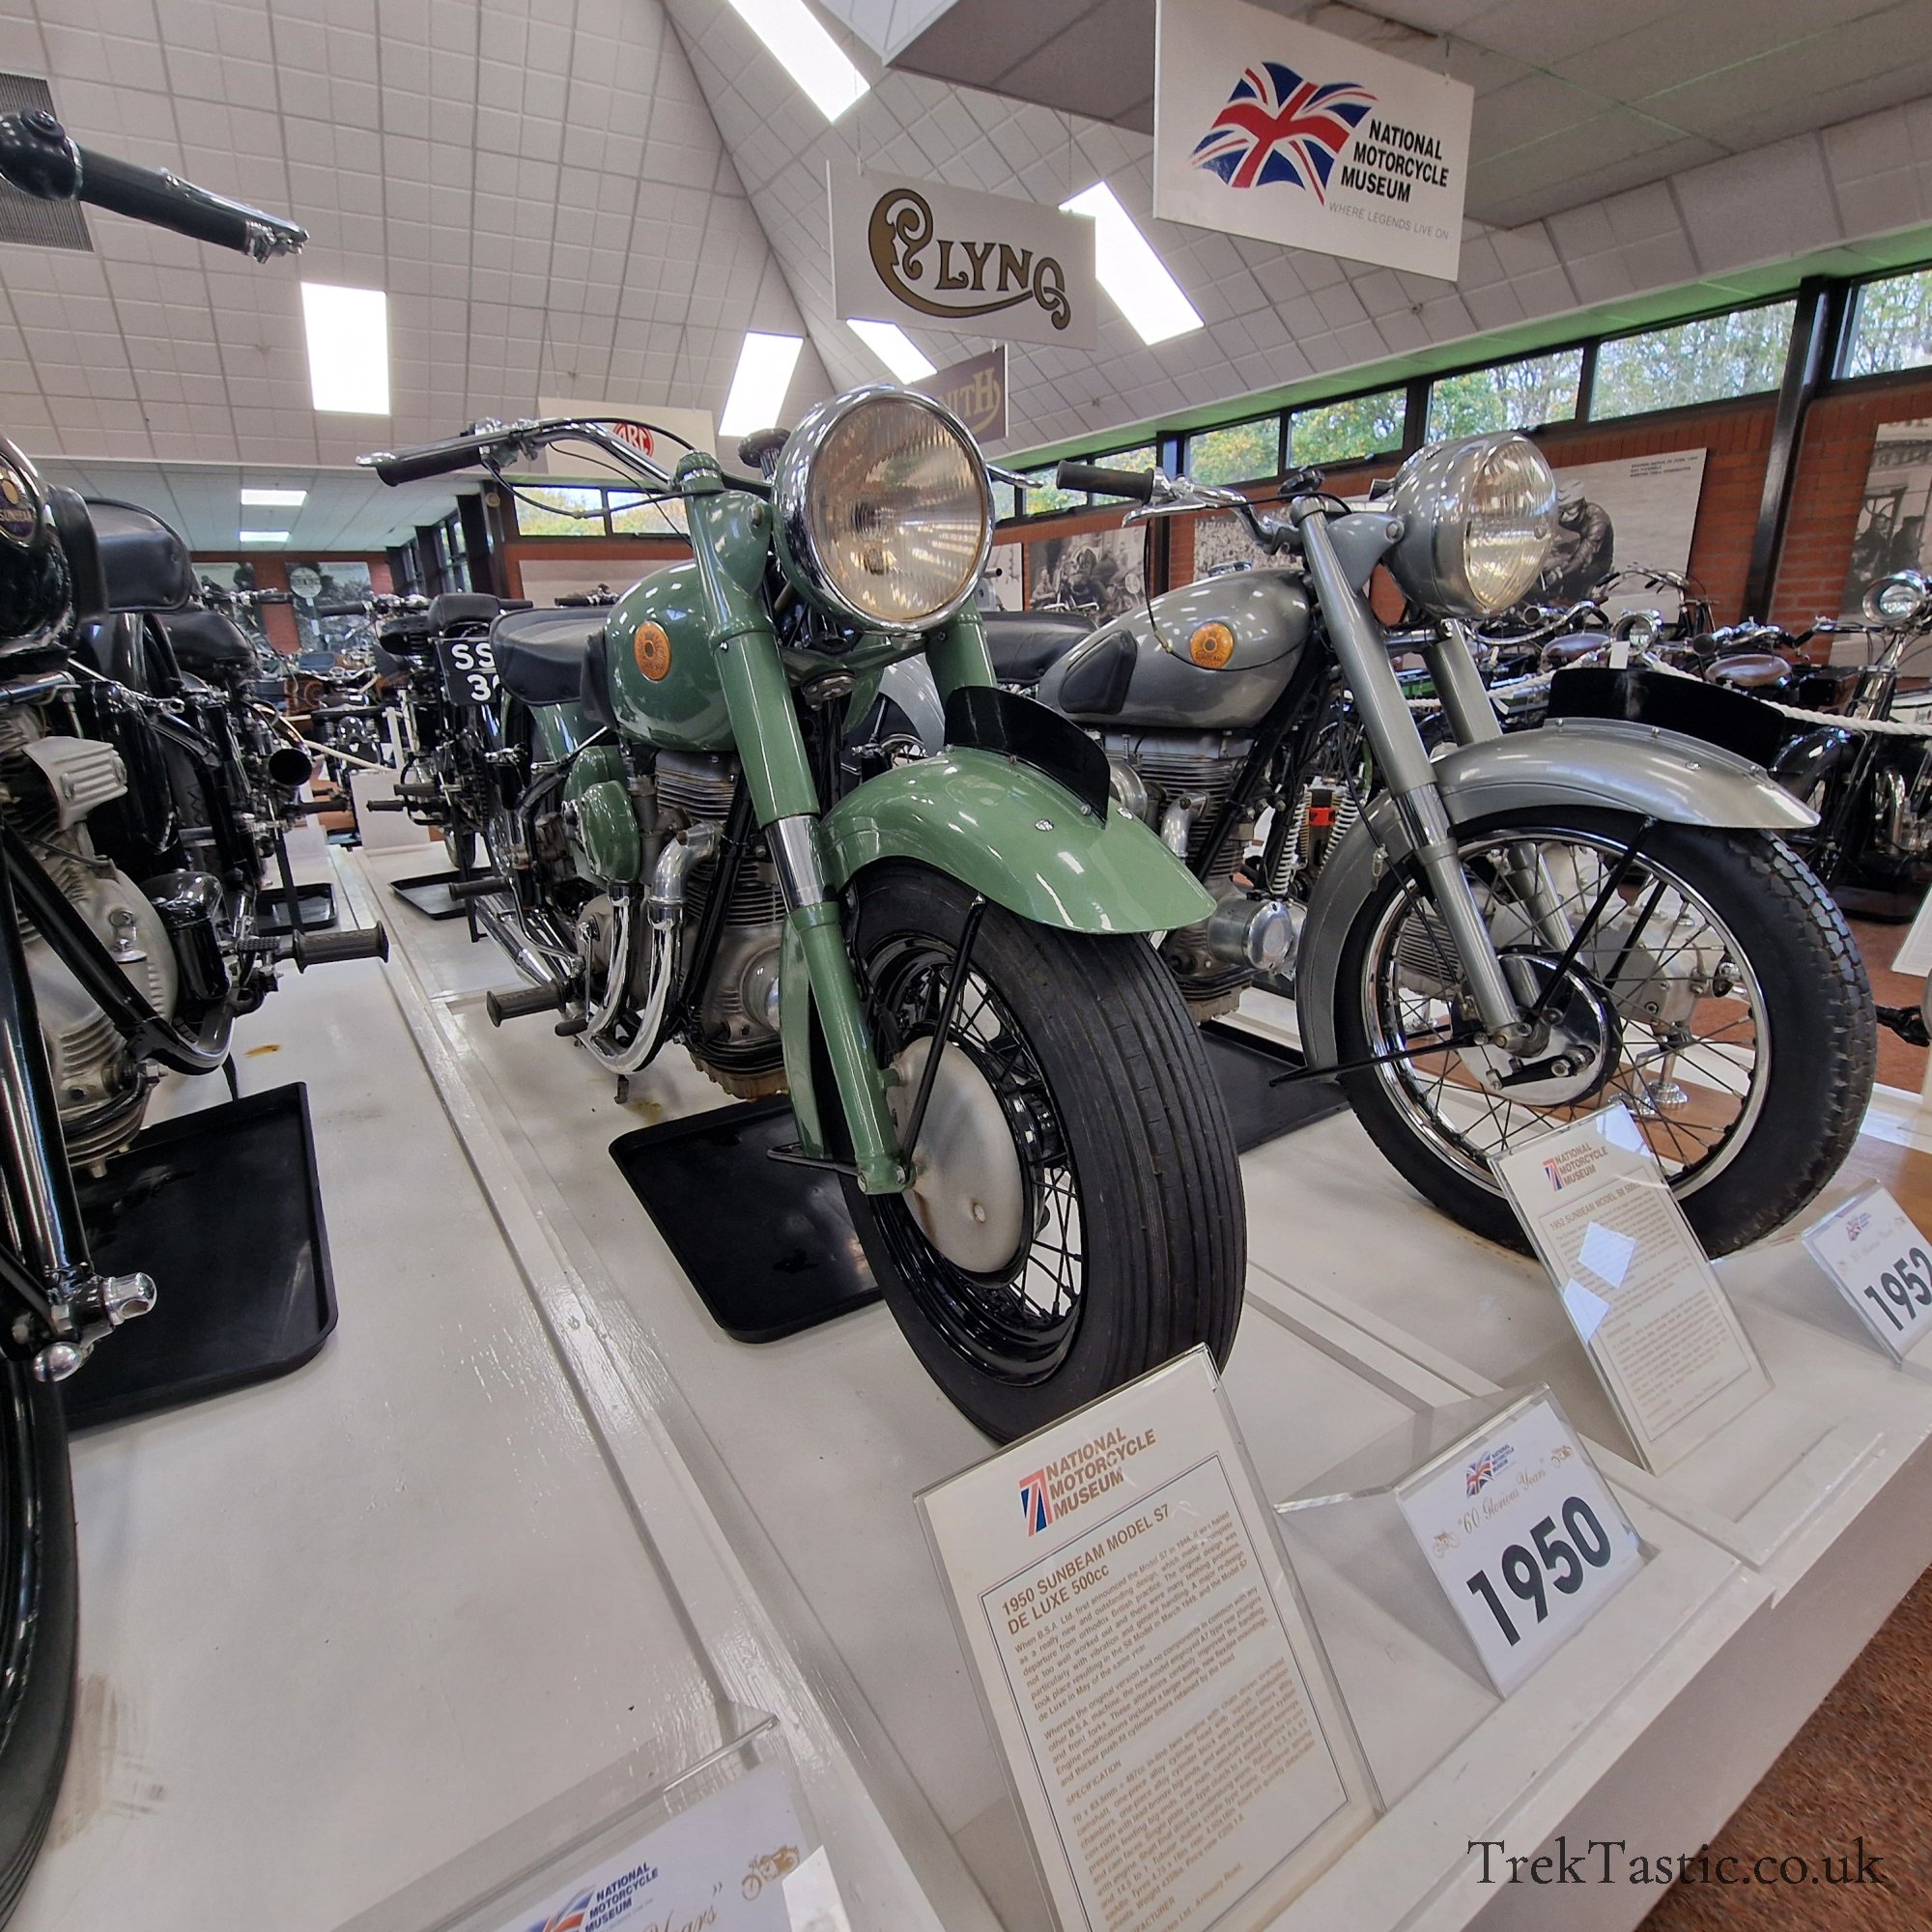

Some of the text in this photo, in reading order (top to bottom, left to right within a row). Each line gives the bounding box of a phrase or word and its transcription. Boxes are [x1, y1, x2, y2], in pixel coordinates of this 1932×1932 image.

[1353, 141, 1449, 187] MOTORCYCLE
[1369, 118, 1442, 160] NATIONAL
[1341, 165, 1411, 203] MUSEUM
[1329, 201, 1449, 240] WHERE LEGENDS LIVE ON
[451, 641, 496, 670] SS
[466, 673, 500, 701] 3
[1554, 1143, 1593, 1164] NATIONAL
[1558, 1147, 1608, 1175] MOTORCYCLE
[1563, 1164, 1597, 1187] MUSEUM
[1564, 1202, 1596, 1224] SUNBEAM
[1594, 1192, 1618, 1208] MODEL
[1863, 1247, 1932, 1331] 1952
[1045, 1427, 1127, 1481] NATIONAL
[1049, 1429, 1157, 1500] MOTORCYCLE
[1052, 1466, 1125, 1520] MUSEUM
[1482, 1489, 1521, 1520] Glorious
[1002, 1502, 1171, 1617] 1950 SUNBEAM MODEL S7
[1465, 1496, 1611, 1647] 1950
[1007, 1562, 1110, 1635] DE LUXE 500cc
[1014, 1636, 1036, 1654] When
[1074, 1600, 1090, 1614] first
[1091, 1577, 1126, 1605] announced
[1127, 1570, 1138, 1580] the
[1019, 1655, 1028, 1664] as
[1039, 1635, 1059, 1651] really
[1062, 1624, 1076, 1636] new
[1079, 1611, 1092, 1626] and
[1094, 1586, 1134, 1615] outstanding
[1022, 1649, 1057, 1676] departure
[1059, 1636, 1076, 1651] from
[1078, 1615, 1108, 1638] orthodox
[1110, 1598, 1133, 1617] British
[1027, 1673, 1039, 1688] not
[1041, 1665, 1054, 1677] too
[1057, 1652, 1071, 1667] well
[1073, 1634, 1098, 1656] worked
[1101, 1624, 1113, 1637] out
[1115, 1614, 1127, 1628] and
[1129, 1603, 1147, 1617] there
[1031, 1668, 1070, 1701] particularly
[1072, 1655, 1088, 1670] with
[1090, 1634, 1119, 1659] vibration
[1121, 1623, 1134, 1636] and
[1136, 1605, 1159, 1629] general
[1034, 1693, 1051, 1711] took
[1052, 1681, 1071, 1700] place
[1072, 1660, 1103, 1684] resulting
[1102, 1654, 1110, 1662] in
[1110, 1646, 1122, 1658] the
[1132, 1623, 1152, 1642] Model
[1037, 1654, 1130, 1721] de Luxe in May of the same
[1065, 1758, 1122, 1805] SPECIFICATION
[589, 1866, 659, 1920] MOTORCYCLE
[596, 1862, 650, 1903] NATIONAL
[584, 1897, 633, 1932] MUSEUM
